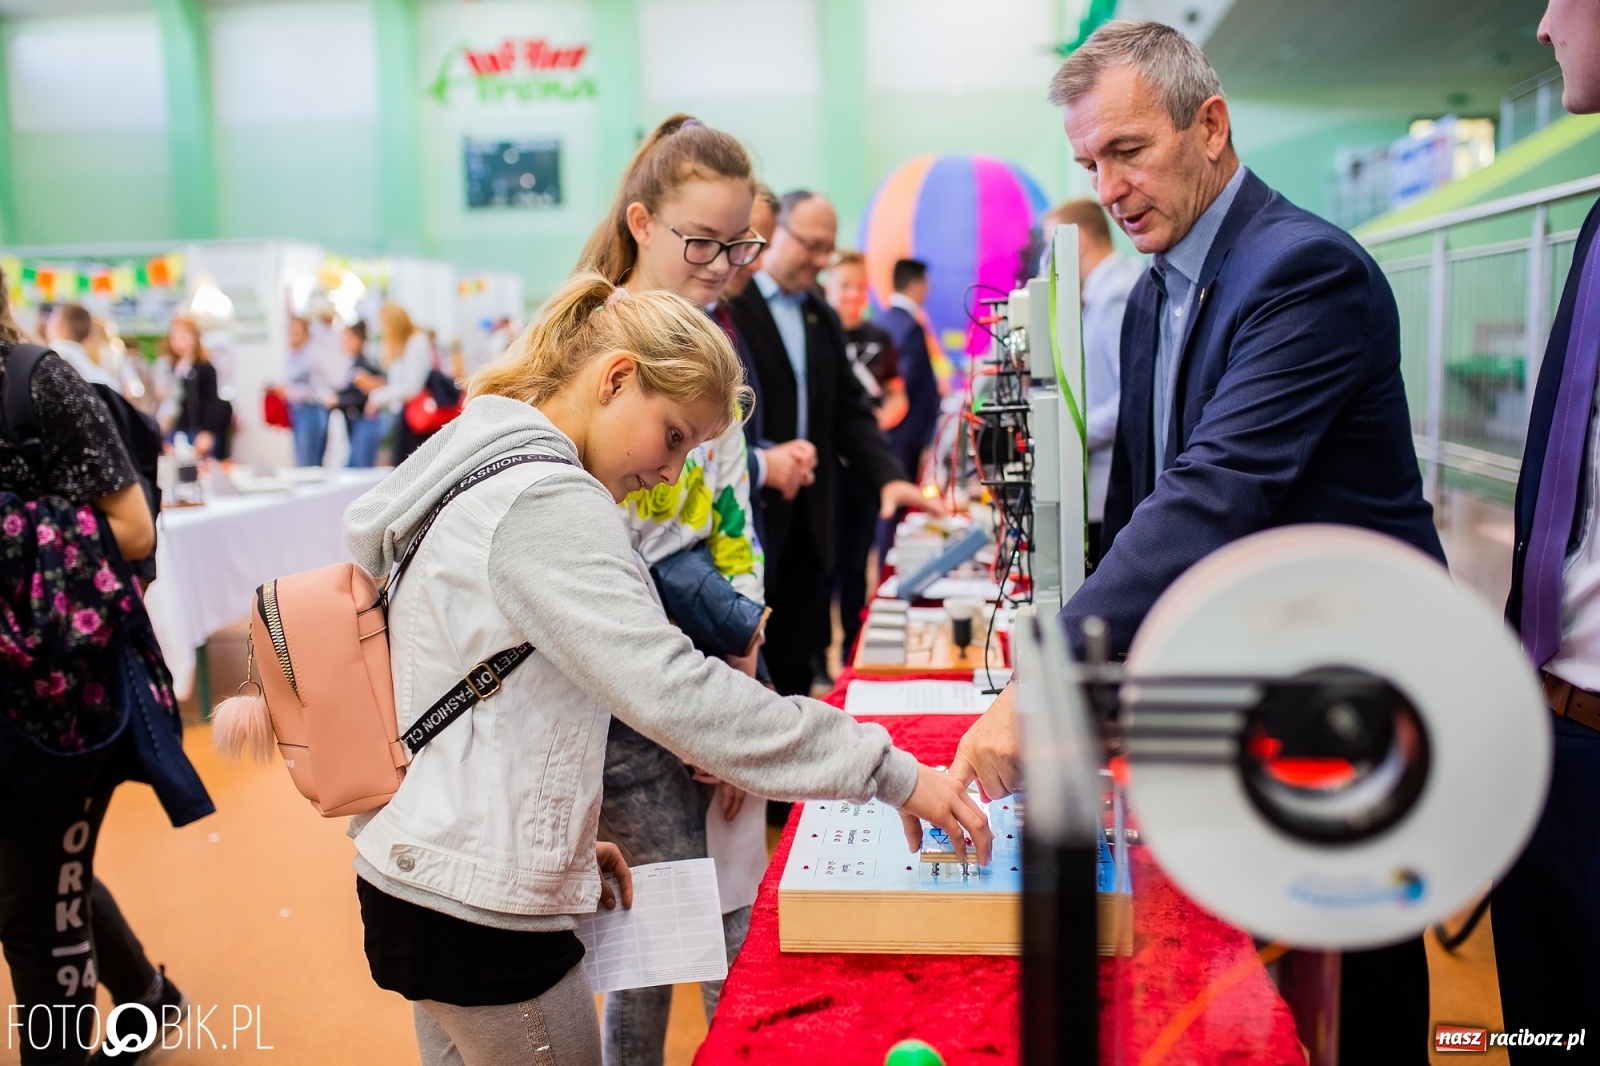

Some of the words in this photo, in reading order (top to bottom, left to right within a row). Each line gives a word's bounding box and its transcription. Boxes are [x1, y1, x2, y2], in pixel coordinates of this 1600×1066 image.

[441, 487, 457, 504] OF
[459, 456, 523, 488] FASHION
[475, 671, 493, 691] OF
[421, 685, 475, 733] FASHION
